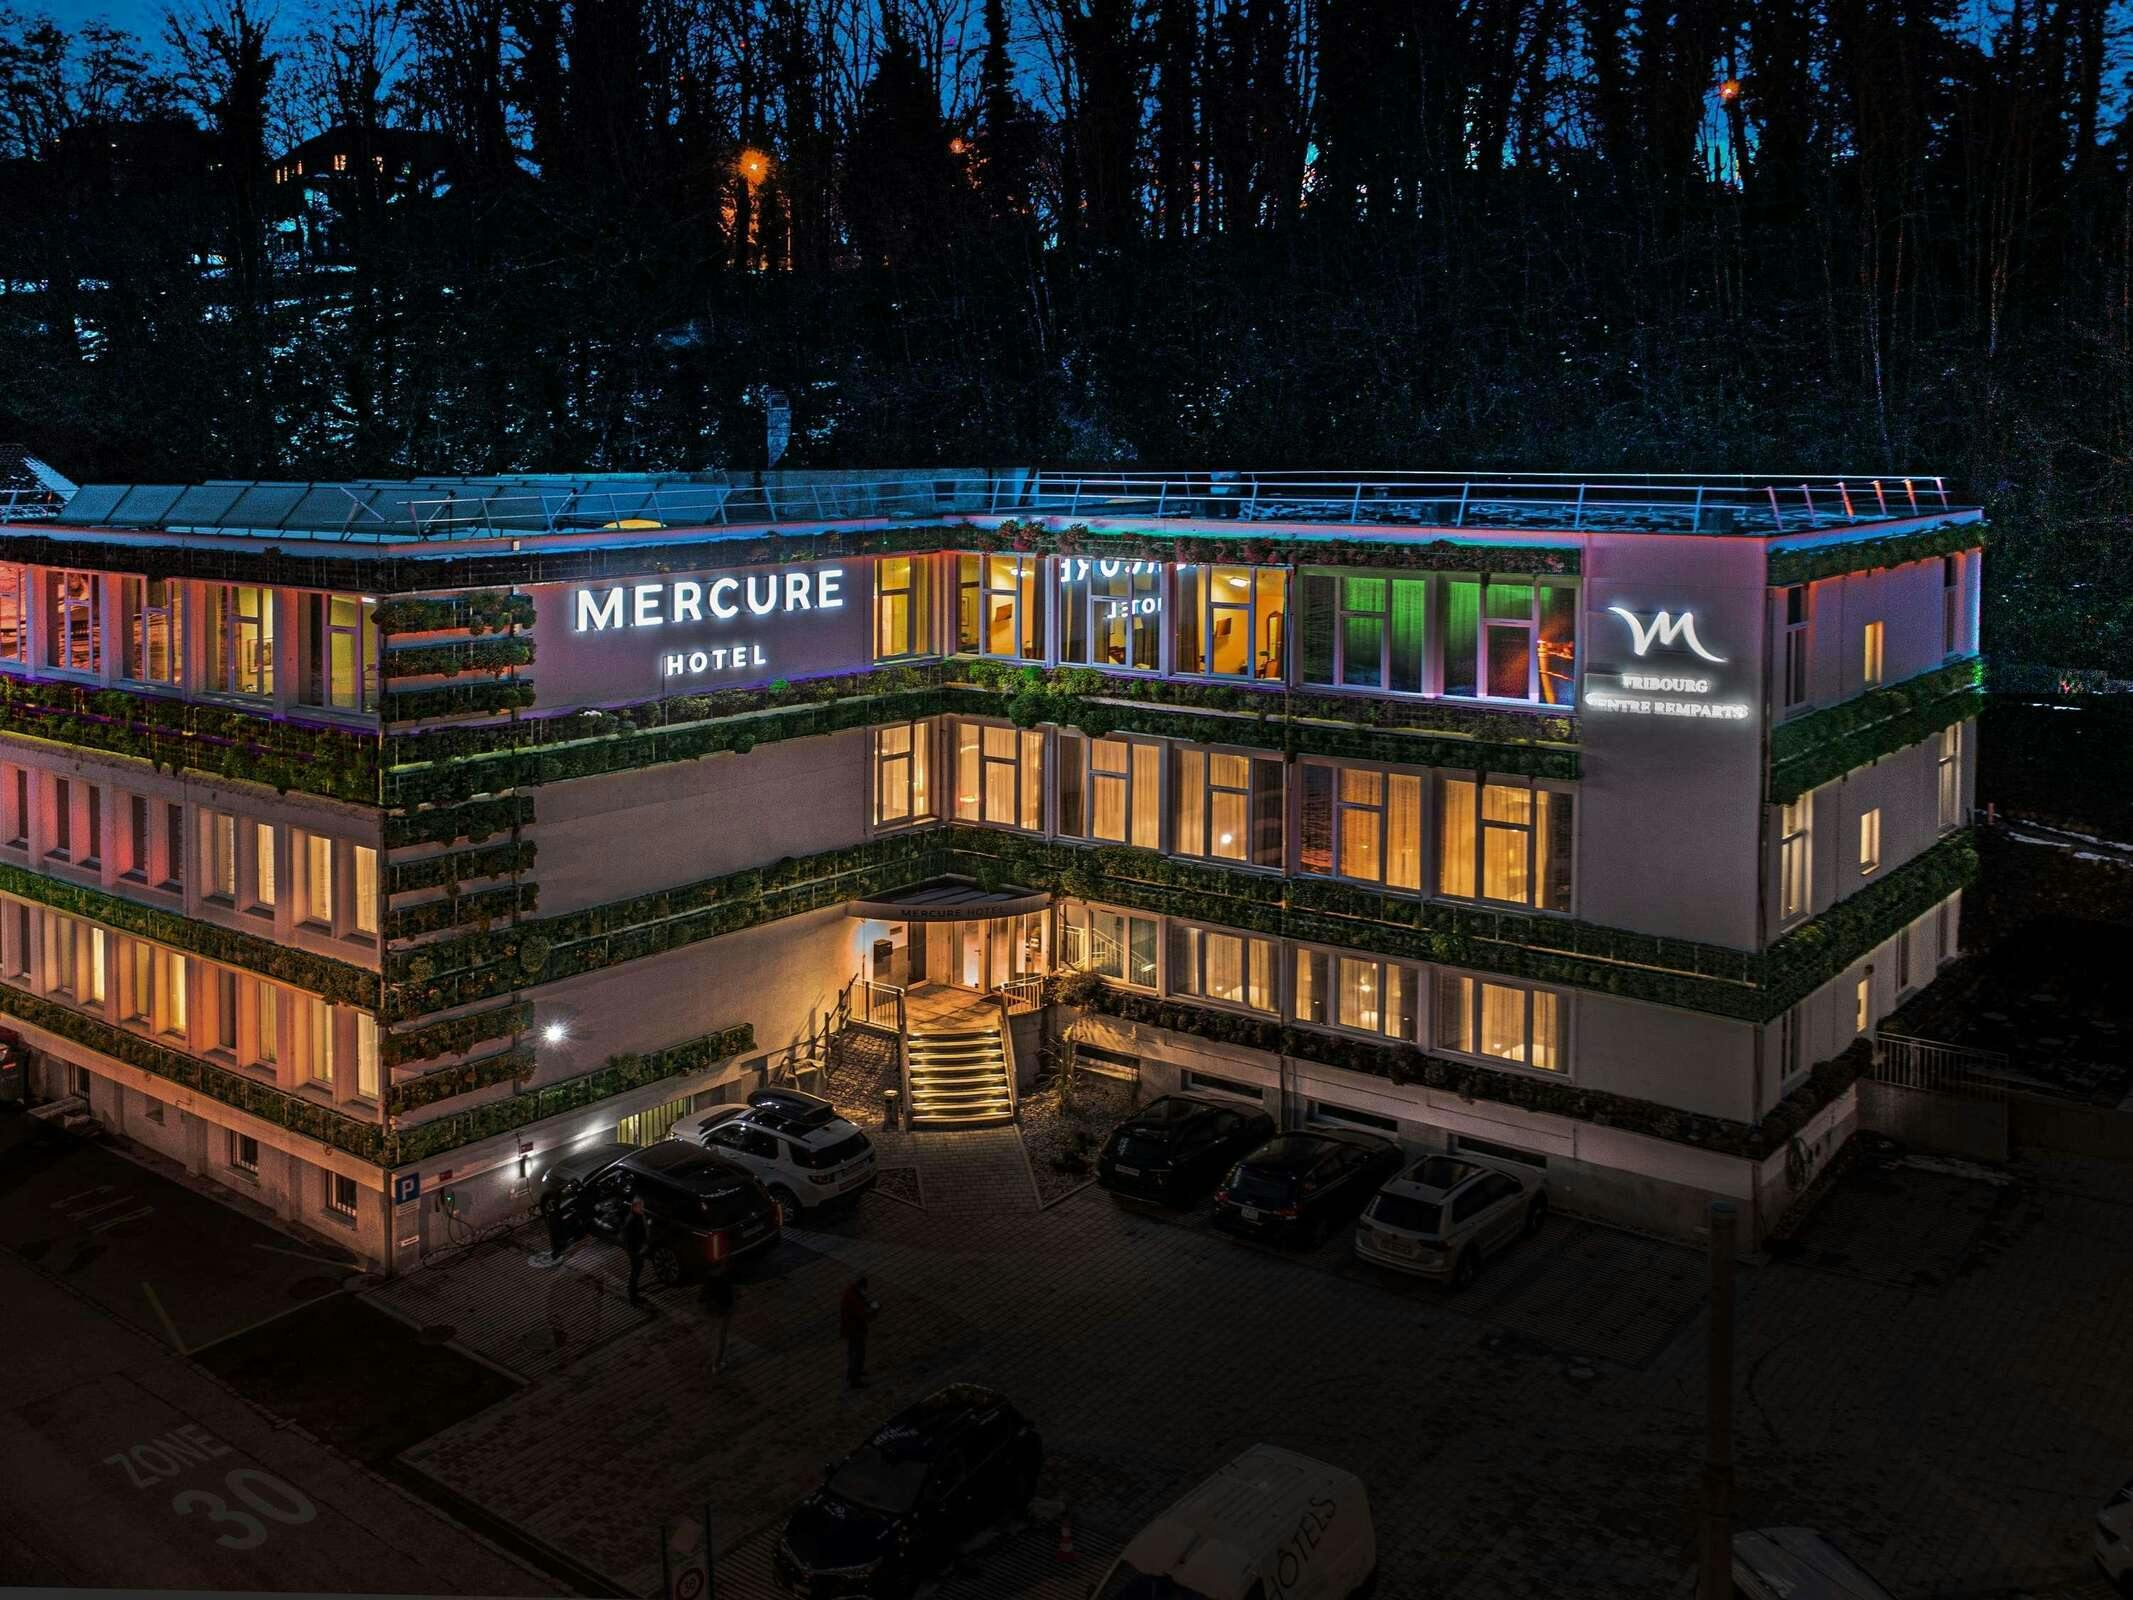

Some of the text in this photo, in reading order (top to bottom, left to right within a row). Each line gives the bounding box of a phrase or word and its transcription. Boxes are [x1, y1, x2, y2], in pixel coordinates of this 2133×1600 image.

[575, 569, 843, 632] MERCURE
[667, 645, 766, 676] HOTEL
[1622, 676, 1709, 693] FRIBOURG
[1585, 693, 1749, 720] CENTRE REMPARTS
[902, 905, 1006, 918] MERCURE HOTEL
[401, 1179, 416, 1201] P
[104, 1422, 232, 1488] ZONE
[172, 1468, 317, 1550] 30
